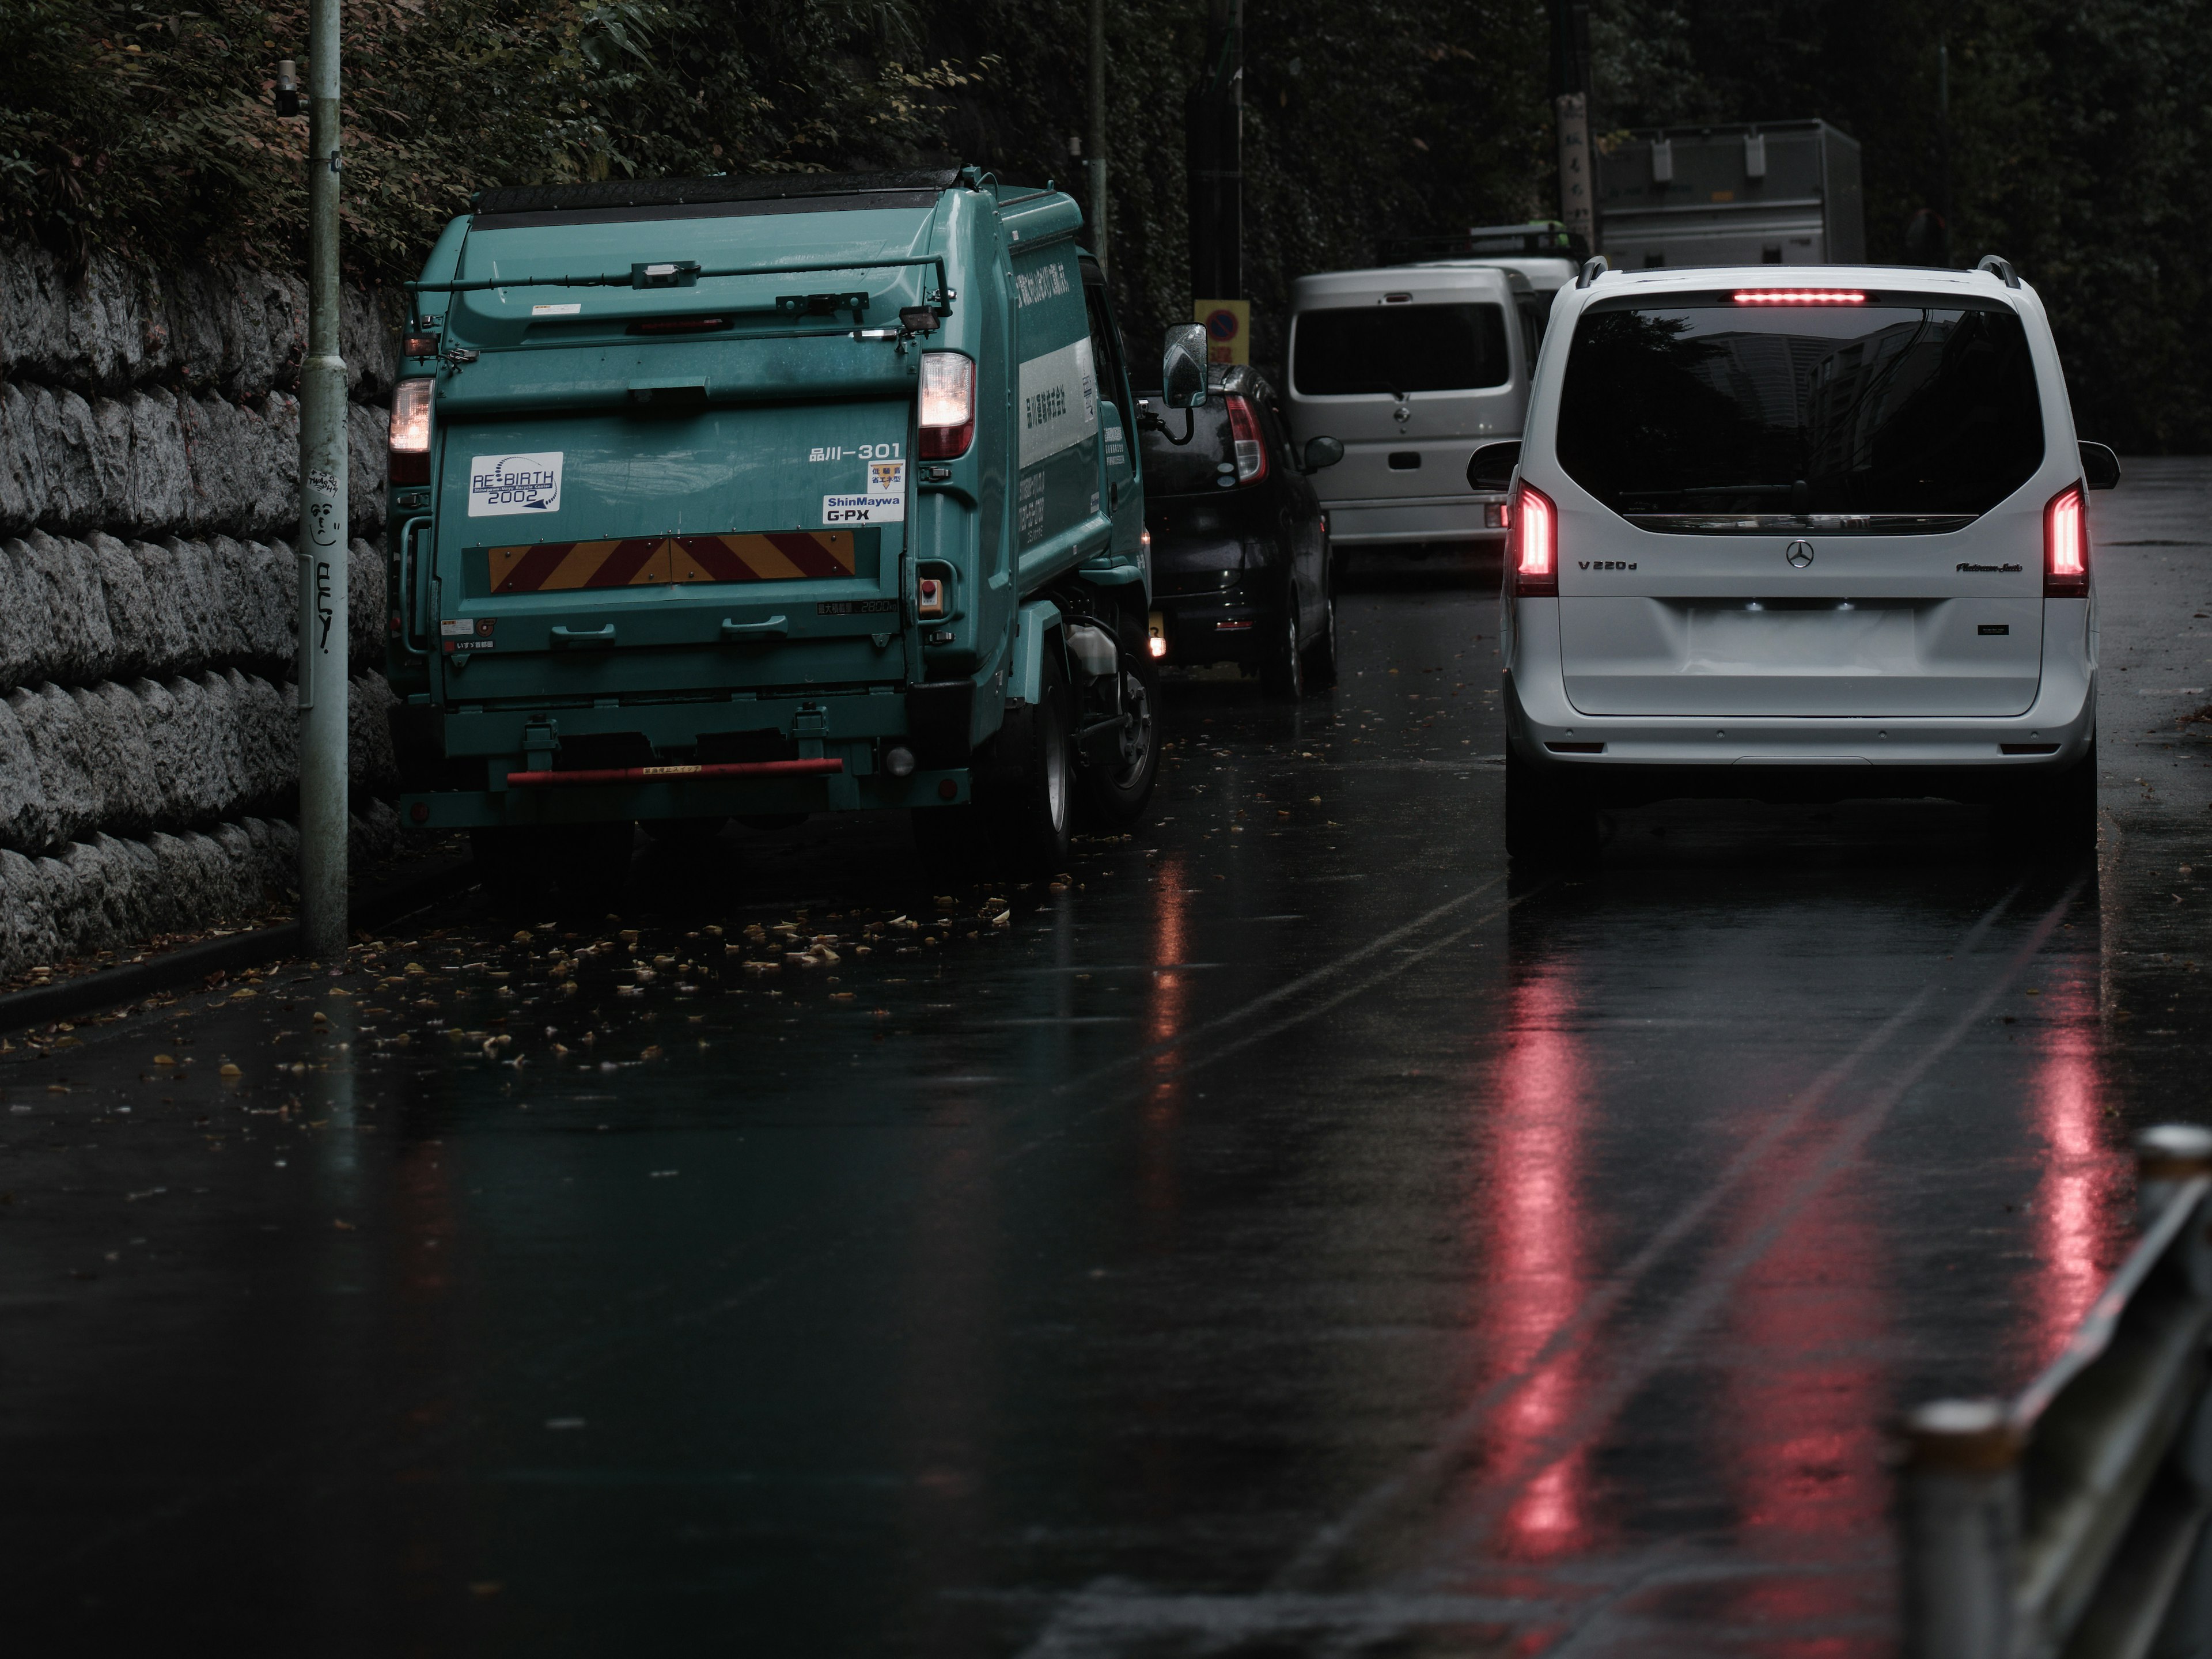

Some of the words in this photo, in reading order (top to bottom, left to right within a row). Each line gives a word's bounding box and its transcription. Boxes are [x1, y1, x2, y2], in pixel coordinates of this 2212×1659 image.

[488, 490, 537, 503] 2002
[828, 497, 900, 507] ShinMaywa
[827, 510, 869, 521] G-PX
[1578, 561, 1590, 570] V
[1593, 561, 1626, 570] 220
[861, 601, 889, 612] 2800
